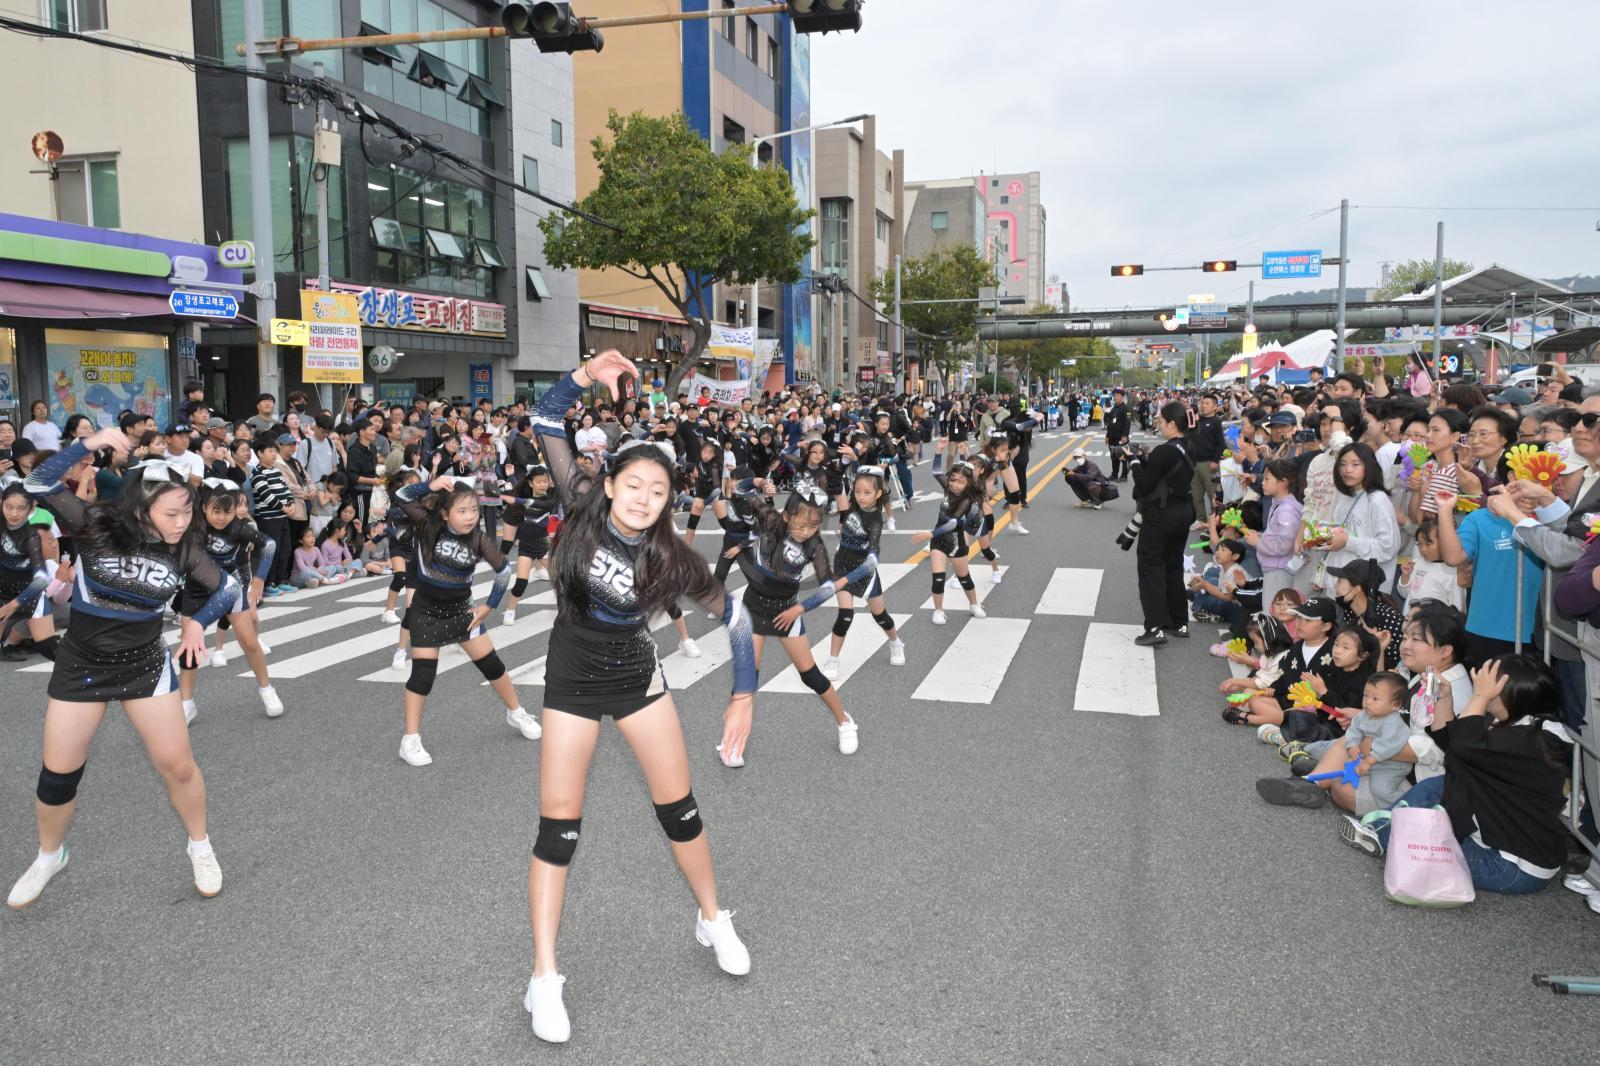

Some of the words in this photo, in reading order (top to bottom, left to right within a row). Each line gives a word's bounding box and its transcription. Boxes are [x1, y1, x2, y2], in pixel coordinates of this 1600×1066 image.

[224, 248, 246, 261] CU
[173, 299, 183, 307] 241
[184, 294, 225, 306] 장생포고래로
[225, 303, 235, 311] 245
[360, 288, 417, 327] 장생포
[424, 299, 473, 332] 고래집
[310, 325, 344, 336] 리퍼레이드
[80, 350, 111, 366] 고래야
[113, 351, 136, 368] 놀자!
[86, 371, 98, 380] CU
[102, 370, 110, 383] 와
[111, 370, 134, 384] 함께!
